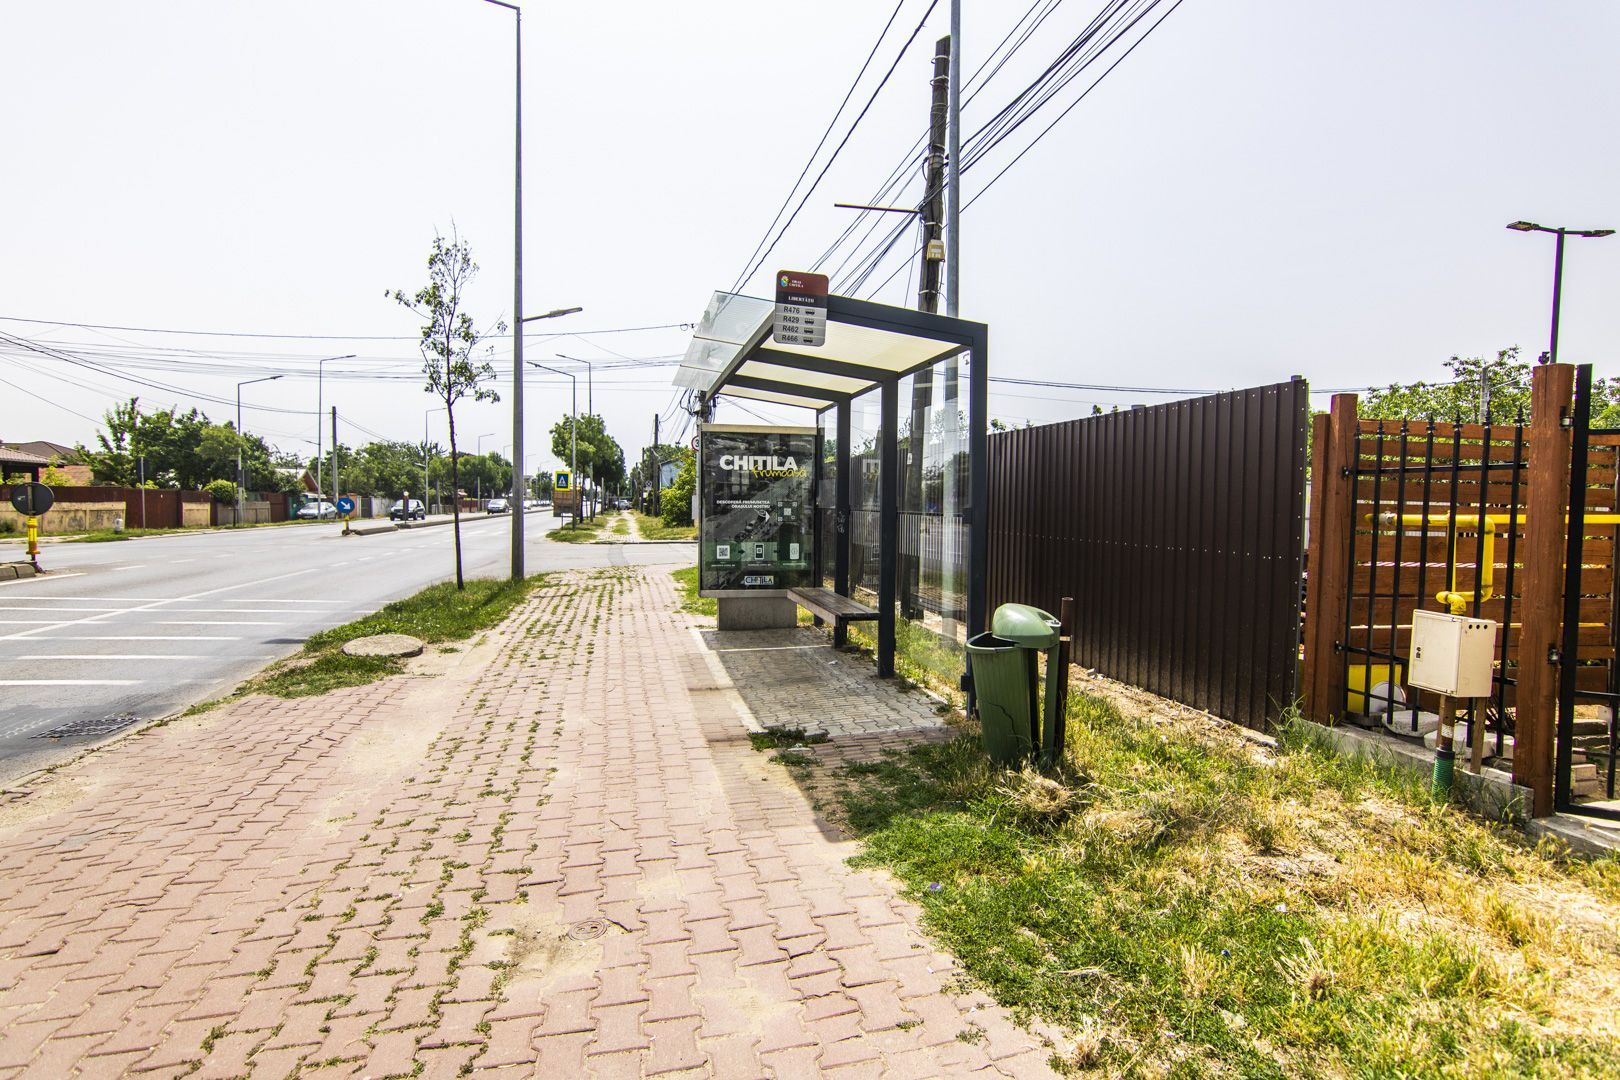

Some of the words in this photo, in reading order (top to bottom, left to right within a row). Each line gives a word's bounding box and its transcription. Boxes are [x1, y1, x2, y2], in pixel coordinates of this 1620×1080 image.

[783, 306, 800, 314] R476
[783, 316, 800, 324] R429
[782, 325, 799, 333] R462
[720, 455, 798, 471] CHITILA
